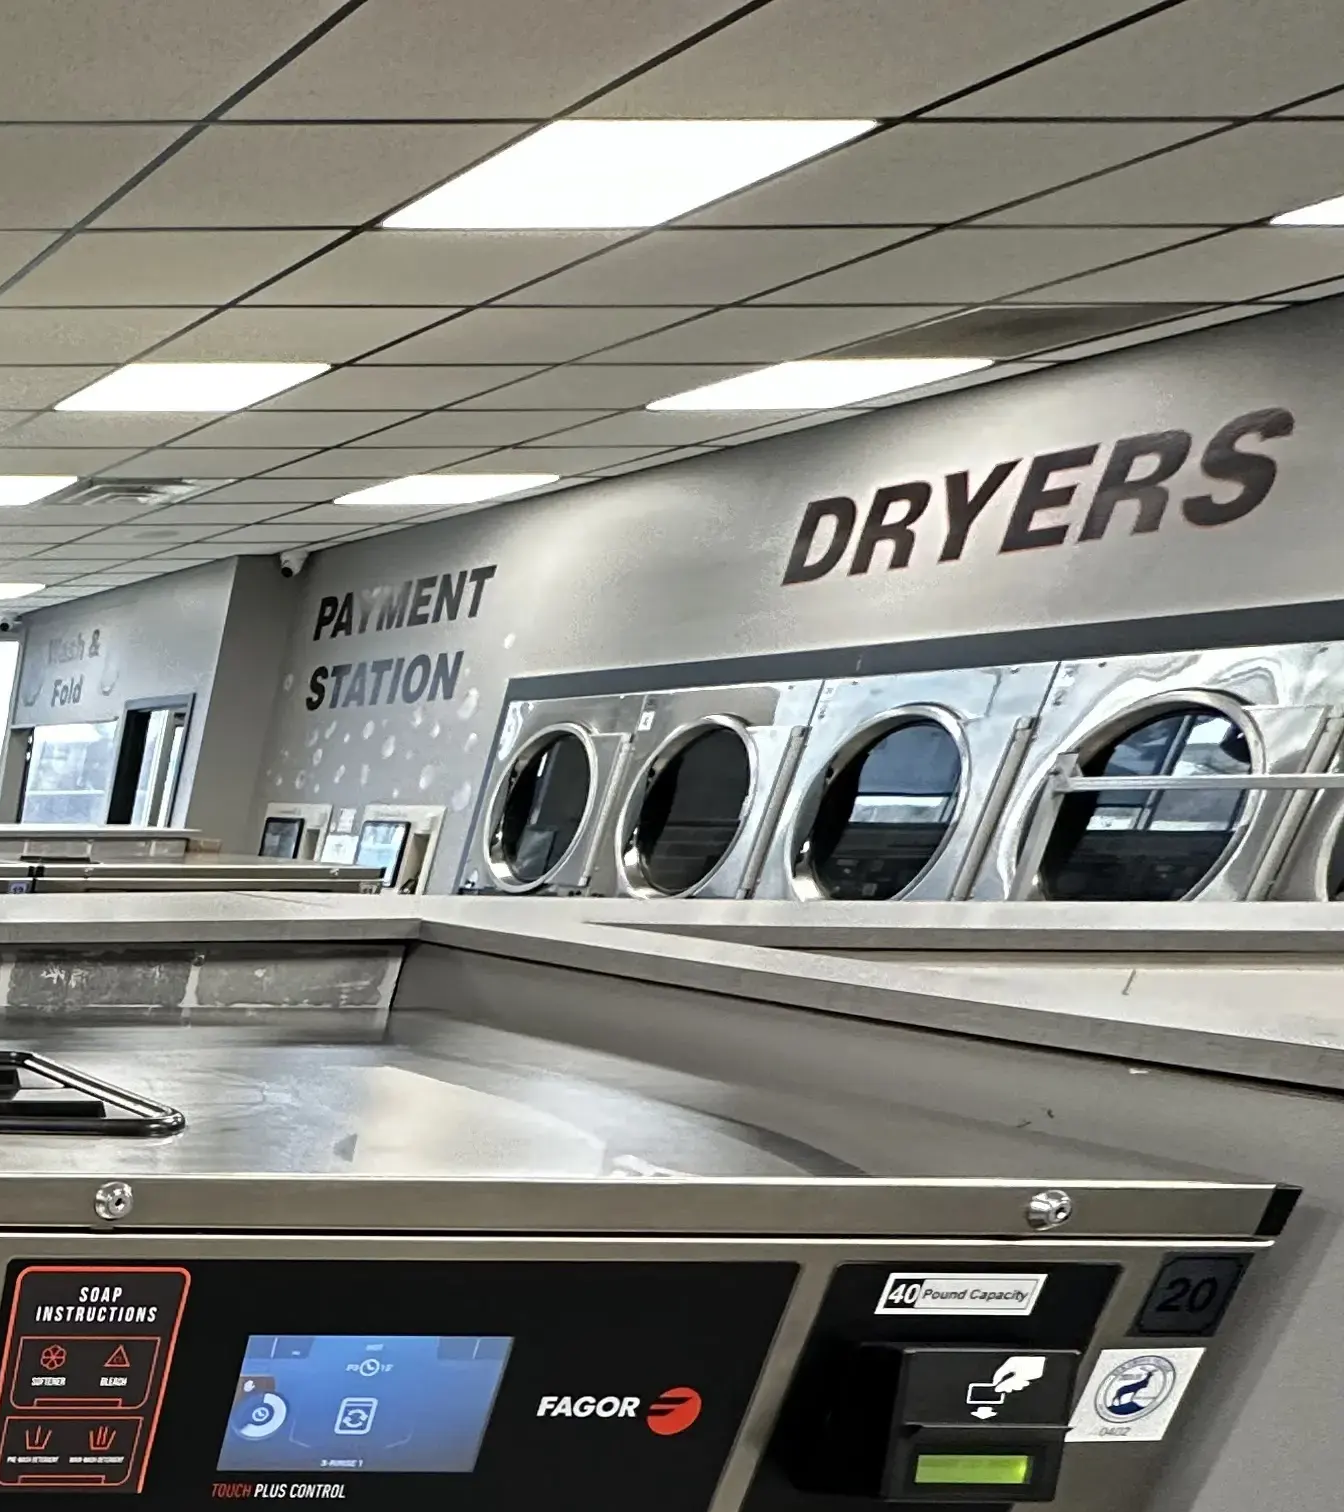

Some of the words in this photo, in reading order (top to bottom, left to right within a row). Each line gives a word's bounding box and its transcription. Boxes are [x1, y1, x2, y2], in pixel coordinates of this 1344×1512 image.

[781, 407, 1294, 586] DRYERS
[313, 565, 497, 641] PAYMENT
[88, 629, 100, 658] &
[51, 674, 83, 707] Fold
[306, 651, 464, 711] STATION
[79, 1287, 122, 1302] SOAP
[888, 1284, 920, 1304] 40
[921, 1289, 967, 1301] Pound
[969, 1289, 1029, 1303] Capacity
[1155, 1277, 1218, 1313] 20
[35, 1306, 157, 1322] INSTRUCTIONS
[537, 1396, 640, 1418] FAGOR
[212, 1483, 252, 1498] TOUCH
[254, 1483, 287, 1498] PLUS
[289, 1484, 345, 1498] CONTROL
